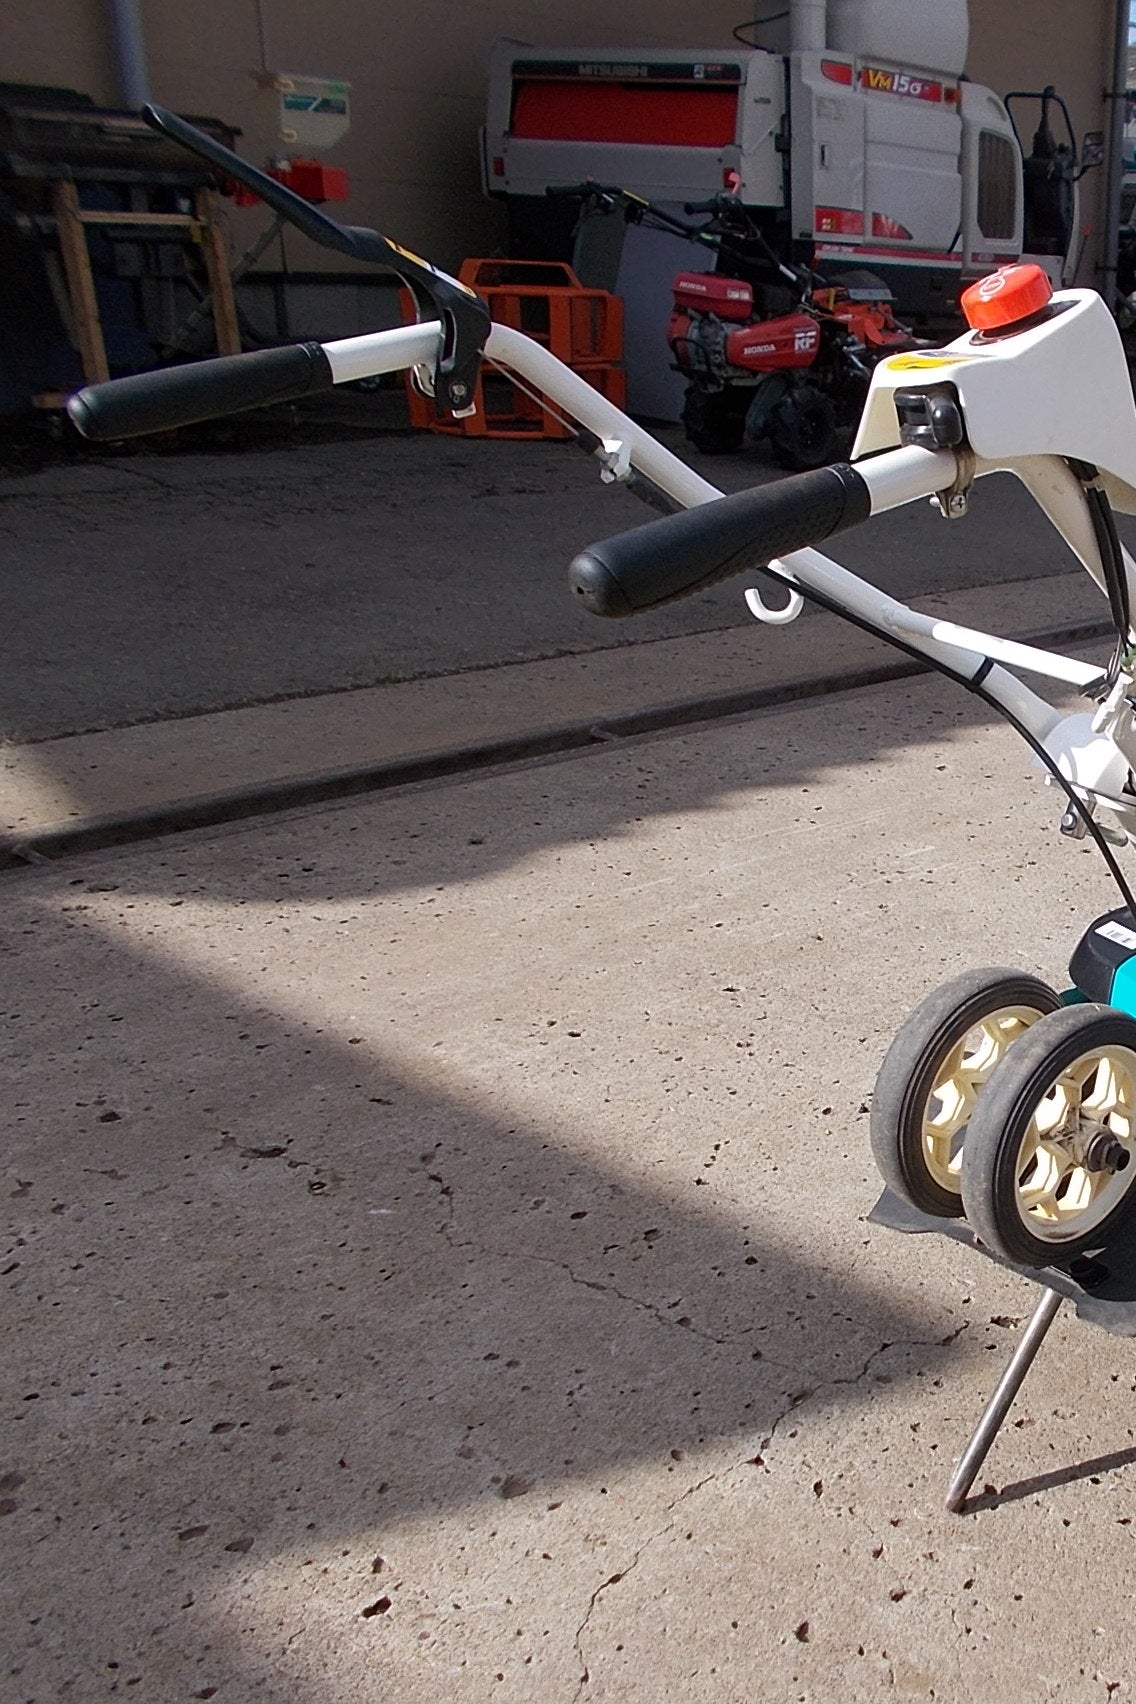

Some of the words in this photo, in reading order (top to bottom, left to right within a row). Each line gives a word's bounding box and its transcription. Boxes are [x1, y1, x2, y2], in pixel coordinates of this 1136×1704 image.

[679, 281, 707, 292] HONDA
[794, 331, 817, 350] RF
[743, 344, 776, 355] HONDA
